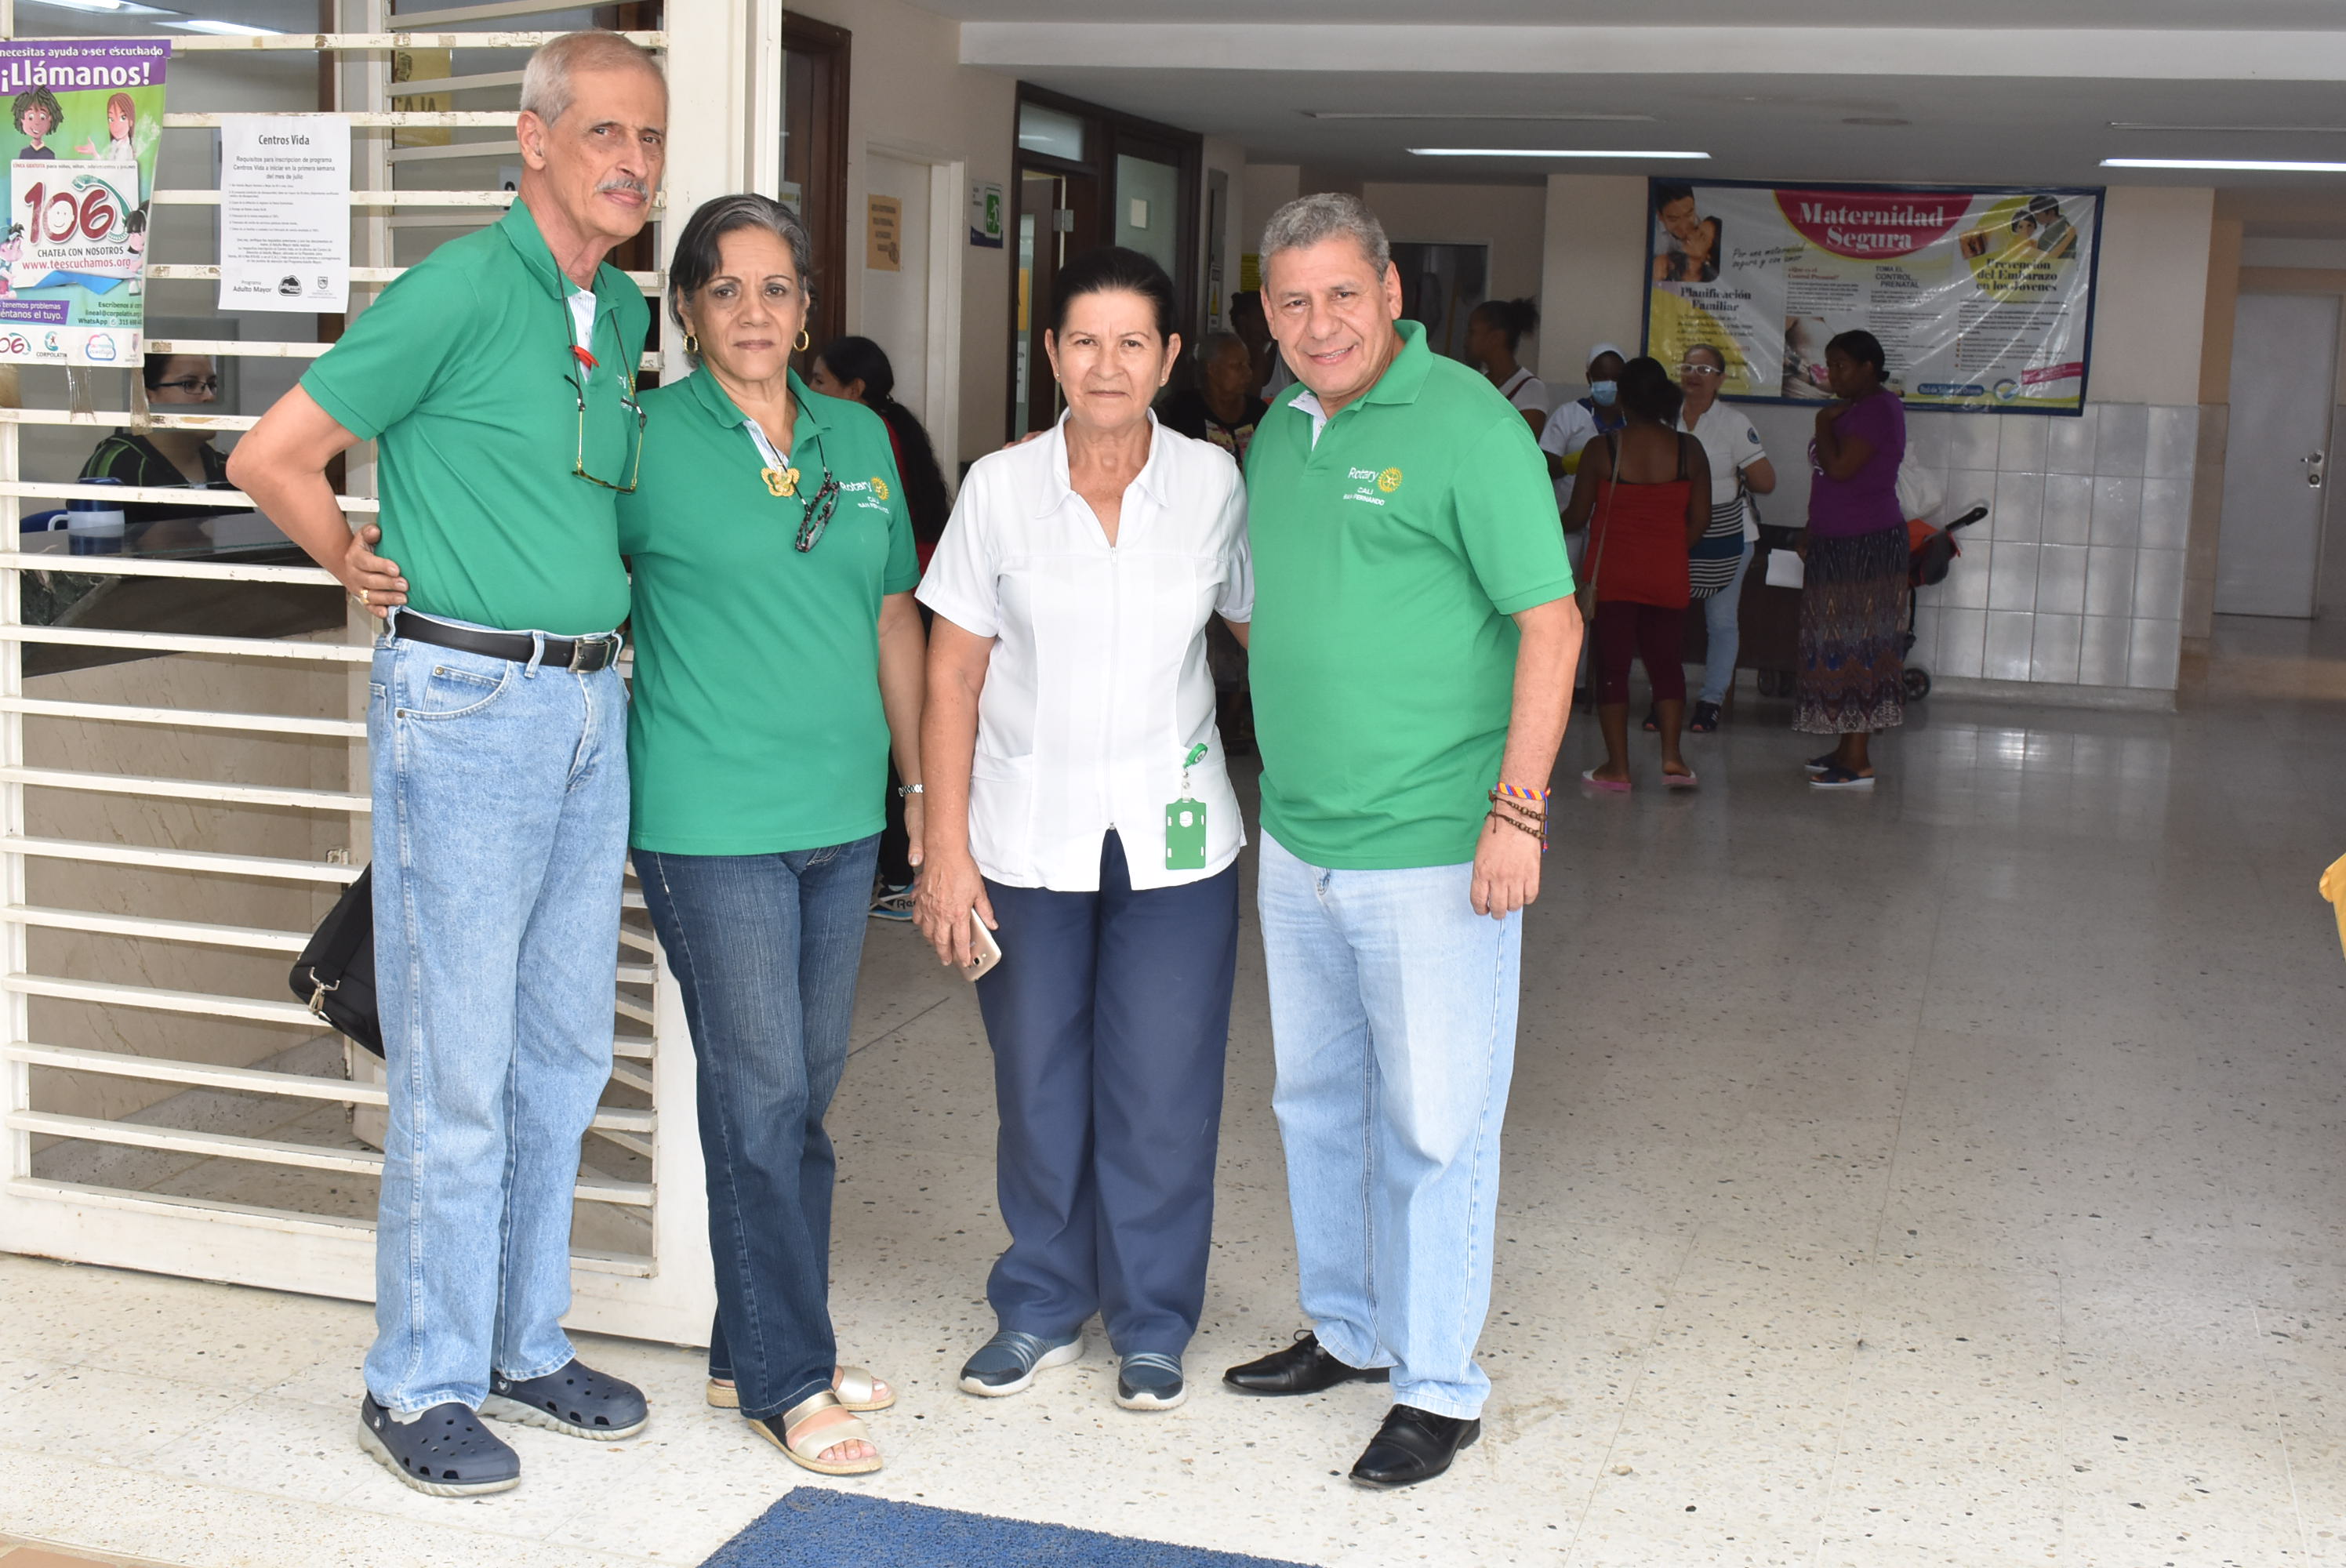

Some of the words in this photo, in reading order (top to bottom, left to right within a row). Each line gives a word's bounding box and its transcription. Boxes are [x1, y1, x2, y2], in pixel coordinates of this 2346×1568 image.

[0, 47, 45, 57] necesitas
[49, 48, 78, 58] ayuda
[109, 46, 163, 56] escuchado
[2, 60, 151, 93] ¡Llámanos!
[259, 134, 289, 145] Centros
[291, 134, 310, 145] Vida
[24, 182, 115, 244] 106
[1799, 202, 1944, 227] Maternidad
[1826, 226, 1912, 252] Segura
[38, 249, 66, 257] CHATEA
[68, 248, 84, 256] CON
[85, 246, 124, 256] NOSOTROS
[1732, 248, 1747, 259] Por
[22, 258, 131, 270] www.teescuchamos.org
[1759, 259, 1766, 269] y
[1987, 258, 2051, 270] Prevención
[1977, 270, 1995, 279] del
[1999, 270, 2057, 281] Embarazo
[1680, 287, 1752, 299] Planificación
[1692, 299, 1740, 311] Familiar
[34, 310, 42, 319] el
[43, 311, 64, 321] tuyo.
[1347, 466, 1379, 483] Rotary
[1357, 487, 1374, 495] CALI
